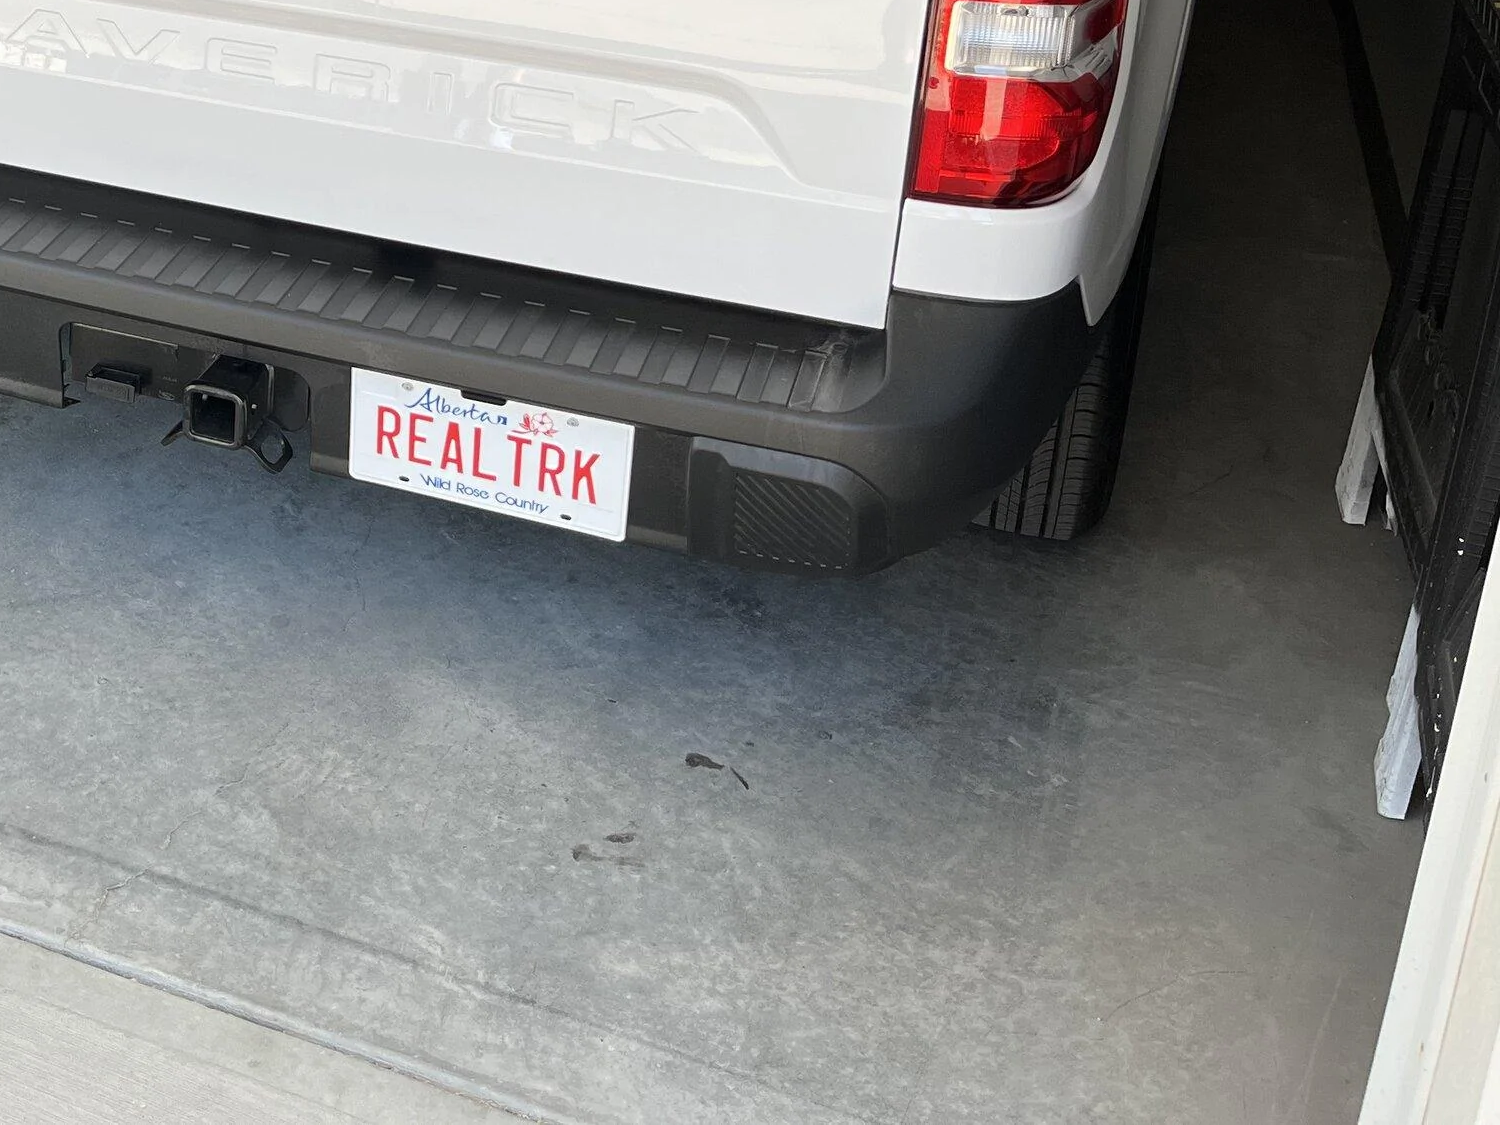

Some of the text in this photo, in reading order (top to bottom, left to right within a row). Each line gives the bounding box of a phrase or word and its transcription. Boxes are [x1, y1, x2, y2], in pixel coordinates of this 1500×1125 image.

[404, 387, 498, 426] Alberta
[376, 405, 601, 505] REALTRK
[419, 473, 549, 515] Wild Rose Country
